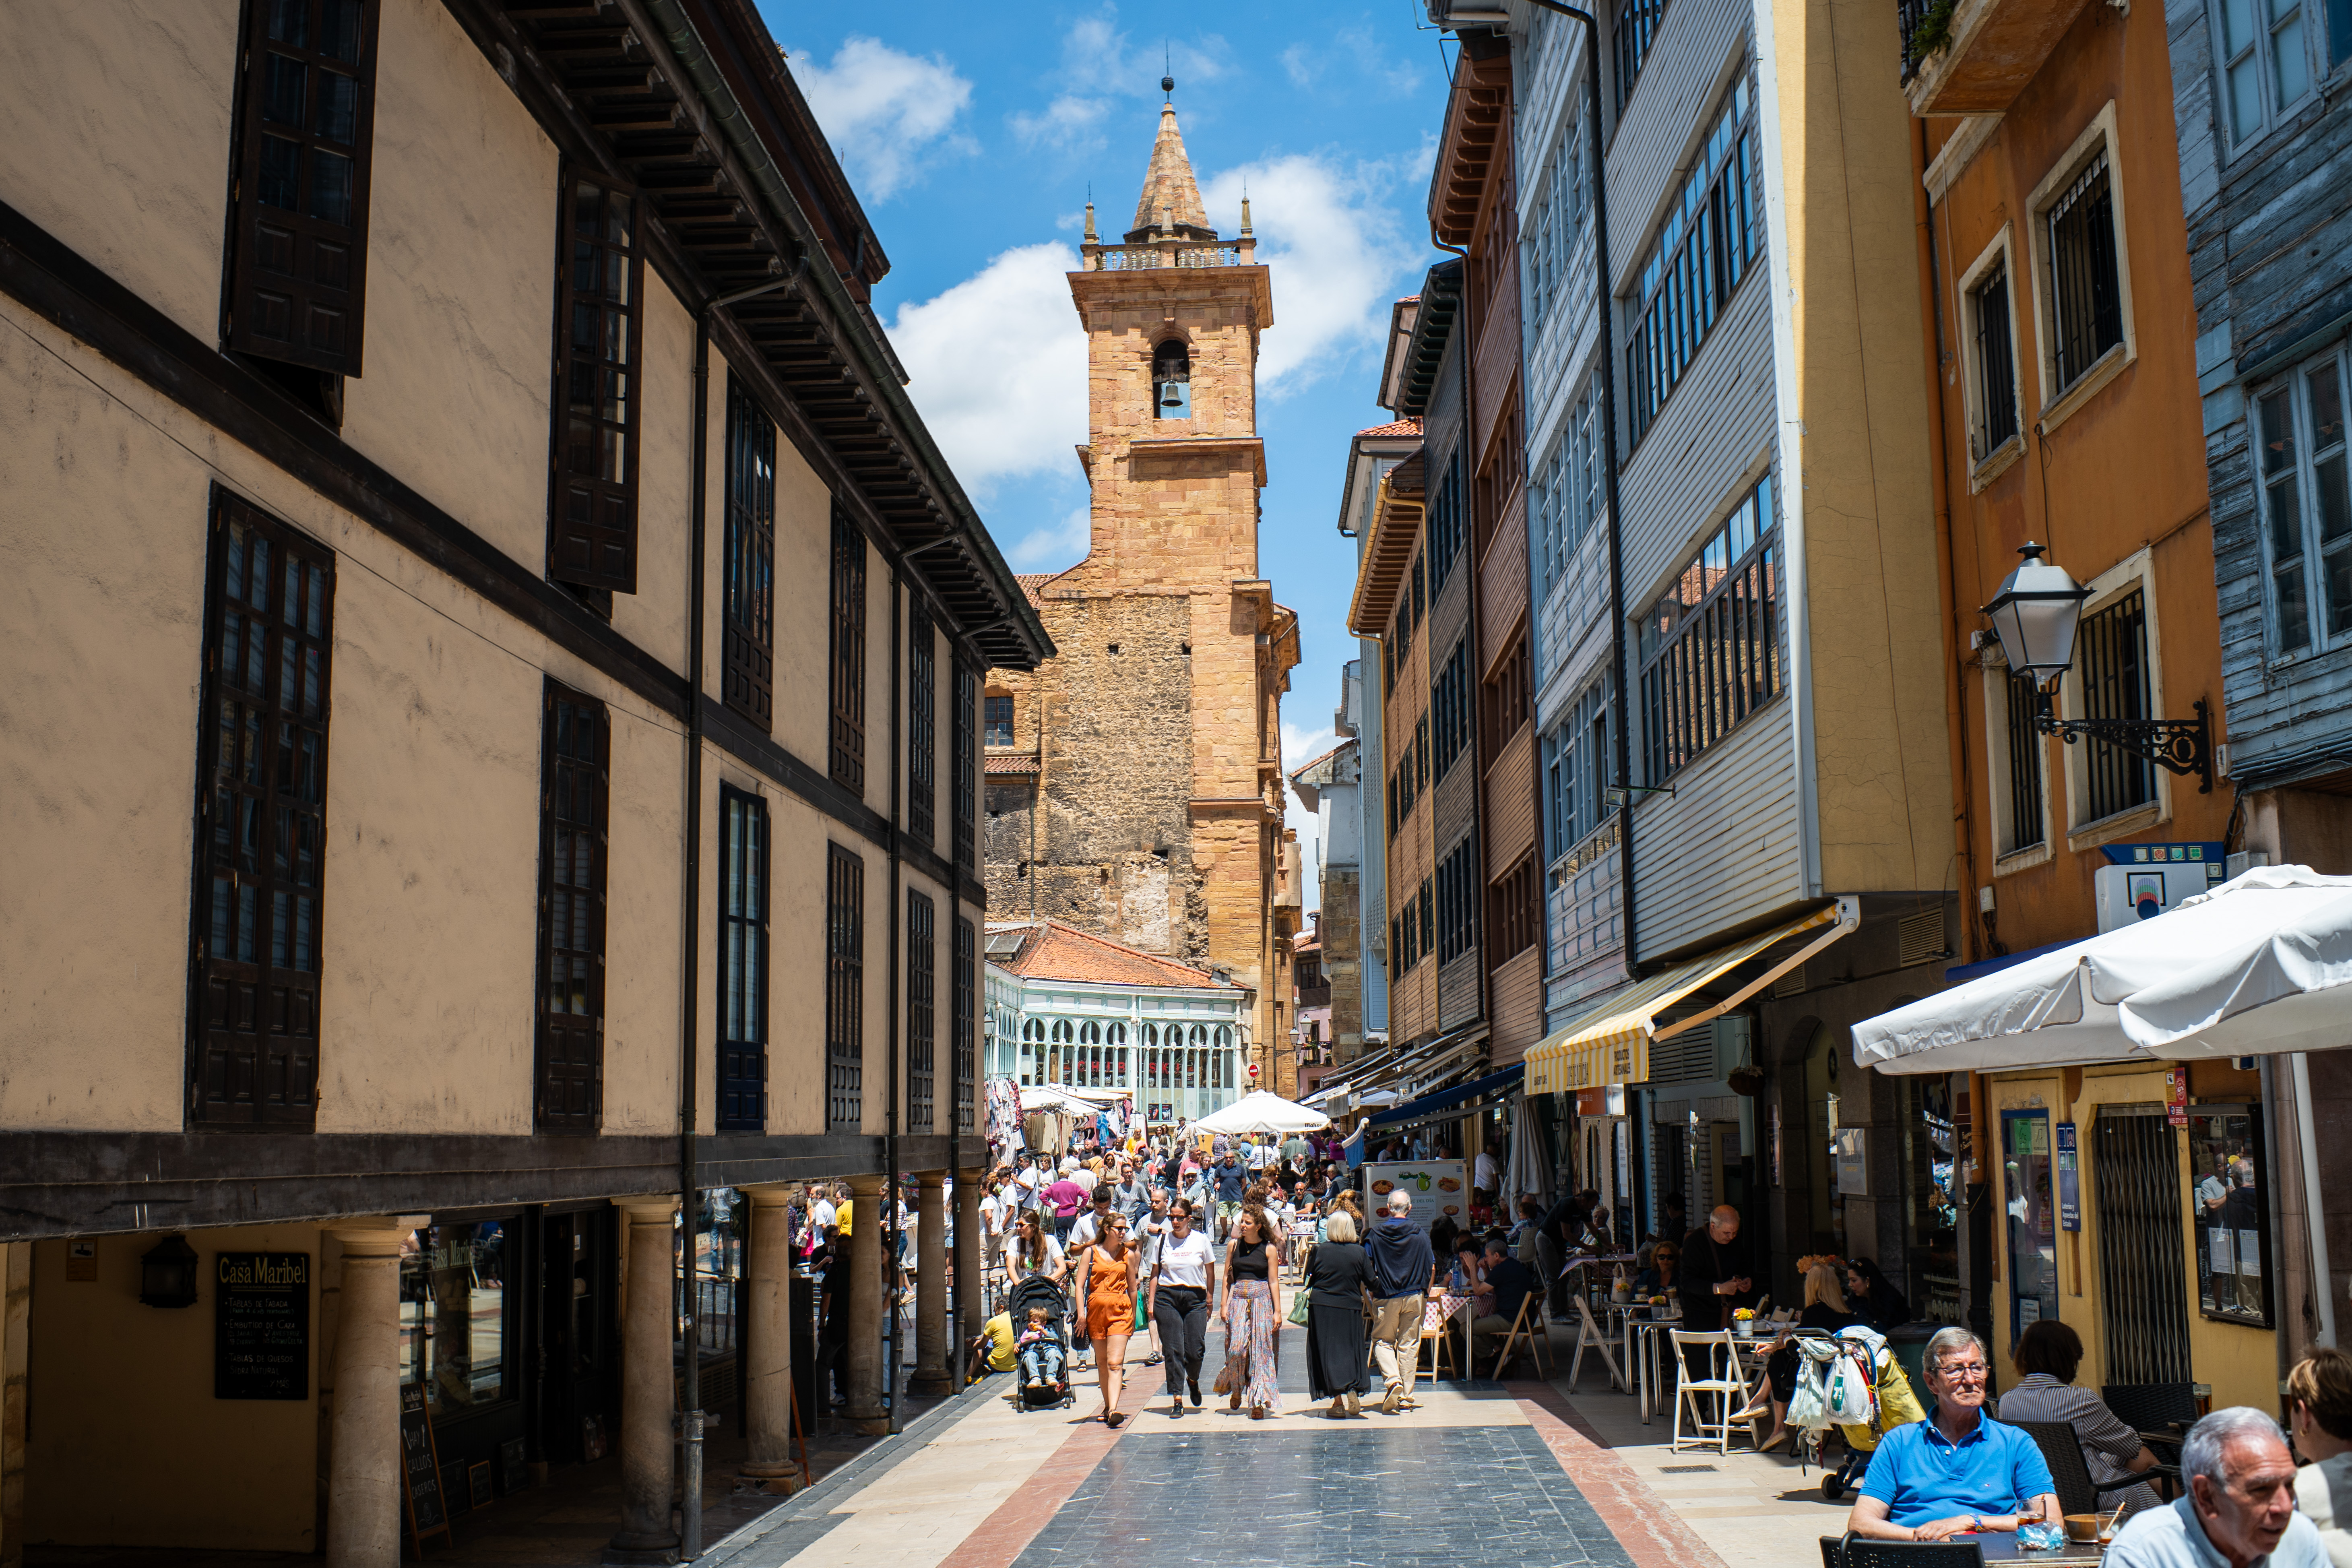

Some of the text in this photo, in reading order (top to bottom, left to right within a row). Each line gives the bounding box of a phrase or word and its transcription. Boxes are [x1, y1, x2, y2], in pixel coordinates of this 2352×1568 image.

[2063, 1211, 2074, 1219] Apuestas
[219, 1256, 306, 1284] Casa Maribel
[227, 1297, 253, 1308] TABLAS
[266, 1298, 288, 1308] FABADA
[229, 1319, 263, 1329] EMBUTIDO
[277, 1319, 295, 1329] CAZA
[229, 1353, 253, 1363] TABLAS
[267, 1355, 293, 1363] QUESOS
[229, 1365, 280, 1375] SIDRA NATURAL
[409, 1430, 419, 1447] HAY
[408, 1454, 432, 1474] CALLOS
[411, 1479, 436, 1500] CASEROS
